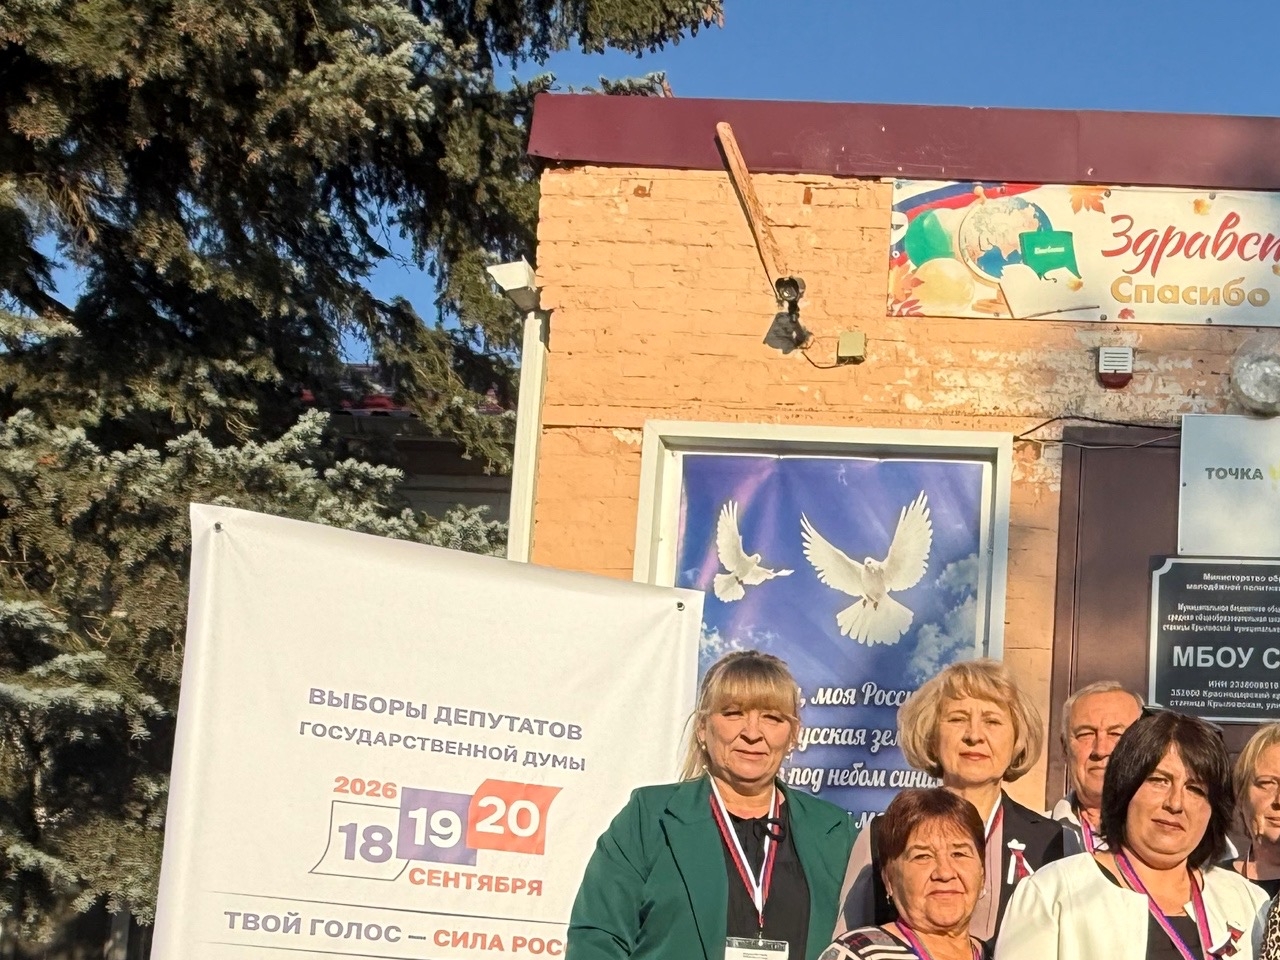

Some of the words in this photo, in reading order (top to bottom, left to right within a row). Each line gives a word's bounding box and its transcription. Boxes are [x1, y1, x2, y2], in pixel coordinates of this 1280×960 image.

[1110, 276, 1270, 307] Спасибо
[1205, 467, 1264, 480] ТОЧКА
[1202, 573, 1266, 582] Министерство
[1172, 645, 1254, 668] МБОУ
[811, 687, 857, 706] моя
[1202, 690, 1270, 699] Краснодарский
[1208, 680, 1227, 688] ИНН
[308, 687, 427, 720] ВЫБОРЫ
[433, 705, 583, 741] ДЕПУТАТОВ
[299, 721, 518, 763] ГОСУДАРСТВЕННОЙ
[522, 749, 586, 772] ДУМЫ
[333, 776, 398, 800] 2026
[788, 767, 824, 793] под
[827, 762, 886, 786] небом
[338, 822, 393, 864] 18
[408, 807, 462, 848] 19
[475, 796, 541, 838] 20
[408, 867, 543, 897] СЕНТЯБРЯ
[223, 910, 302, 936] ТВОЙ
[309, 918, 402, 944] ГОЛОС
[433, 929, 504, 953] СИЛА
[512, 935, 567, 956] РОС
